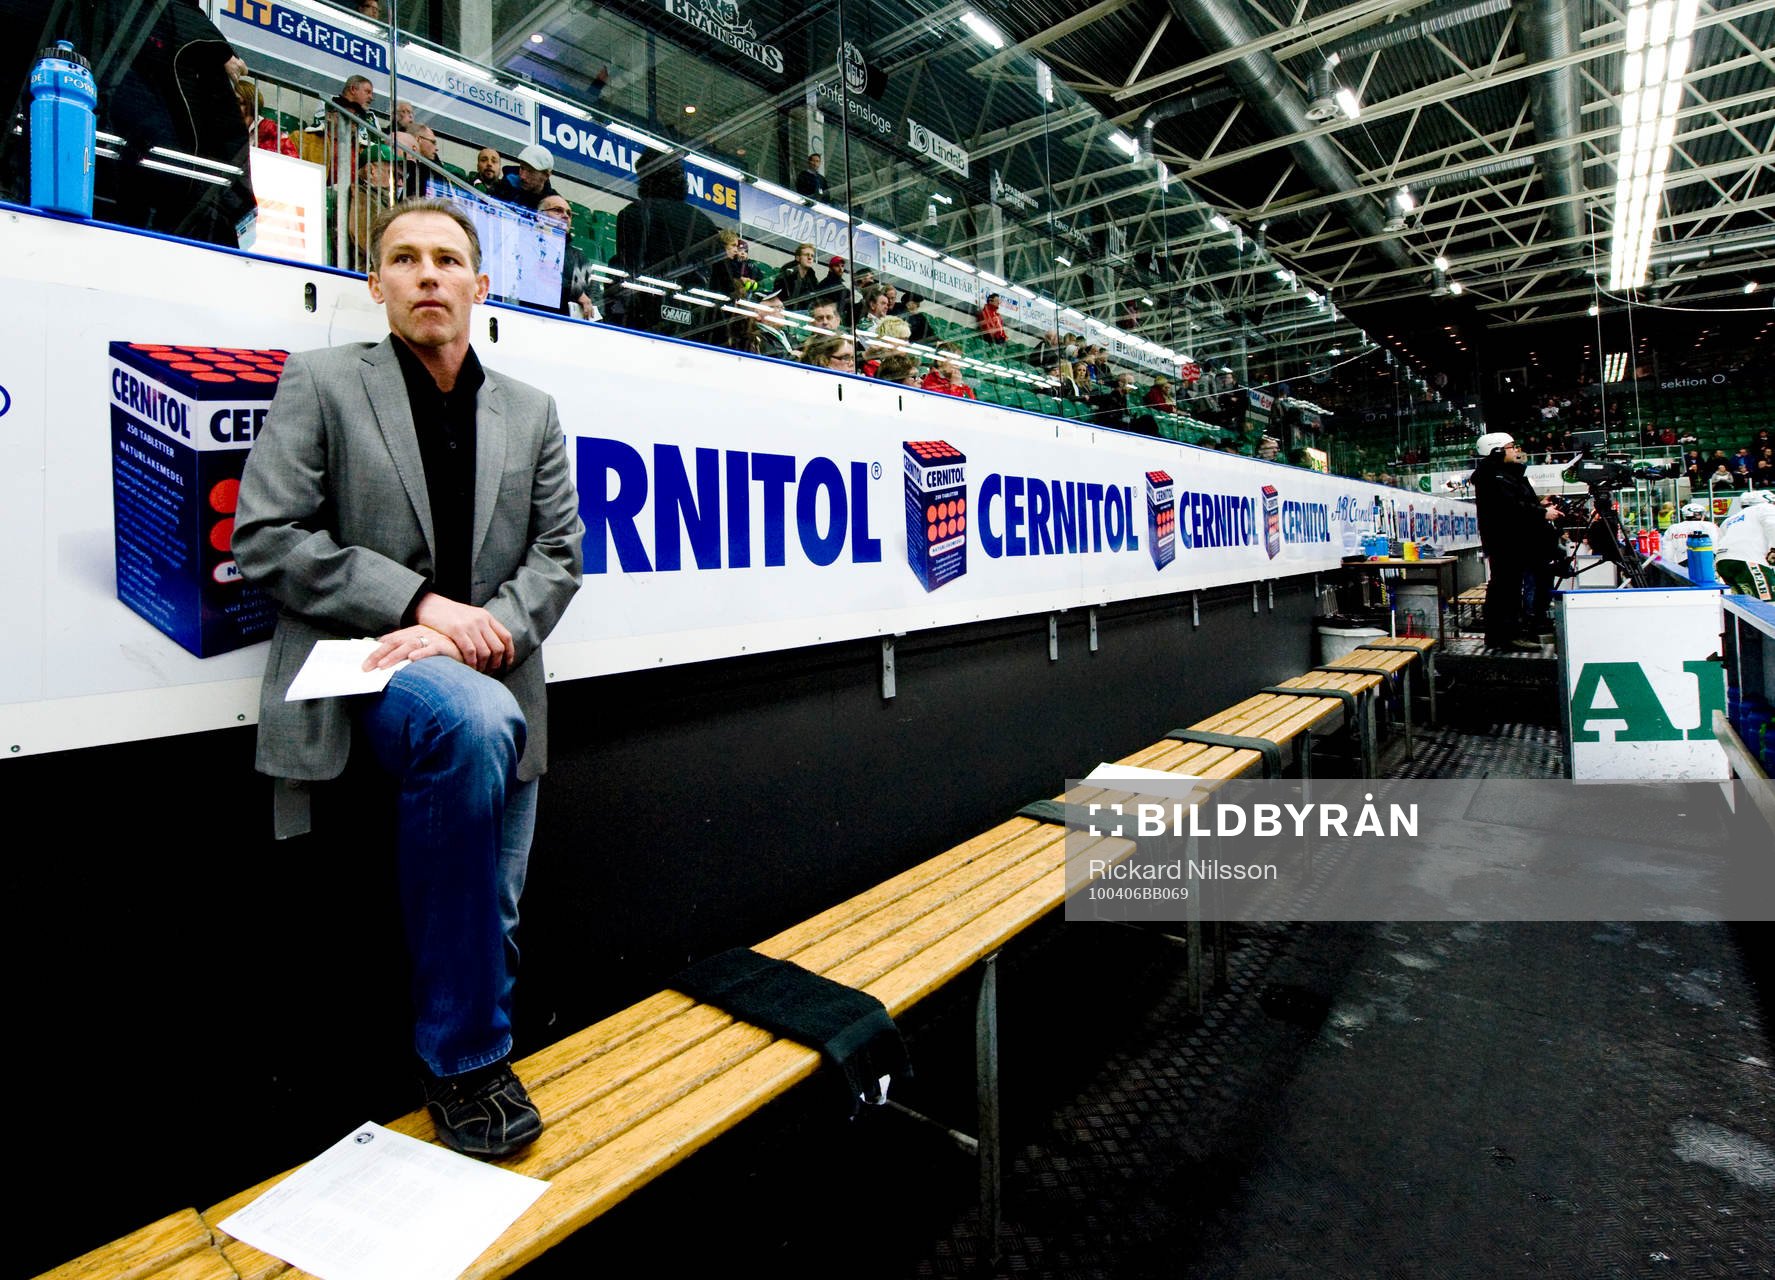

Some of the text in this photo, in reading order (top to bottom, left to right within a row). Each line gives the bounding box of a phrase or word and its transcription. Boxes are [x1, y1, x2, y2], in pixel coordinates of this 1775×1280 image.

[277, 11, 381, 68] GÅRDEN
[931, 137, 965, 171] Lindab
[887, 250, 918, 272] EKEBY
[1660, 376, 1707, 389] sektion
[112, 367, 191, 440] CERNITOL
[139, 430, 175, 458] TABLETTER
[926, 467, 965, 488] CERNITOL
[978, 473, 1139, 559] CERNITOL
[1179, 490, 1259, 549] CERNITOL
[1282, 499, 1330, 544] CERNITOL
